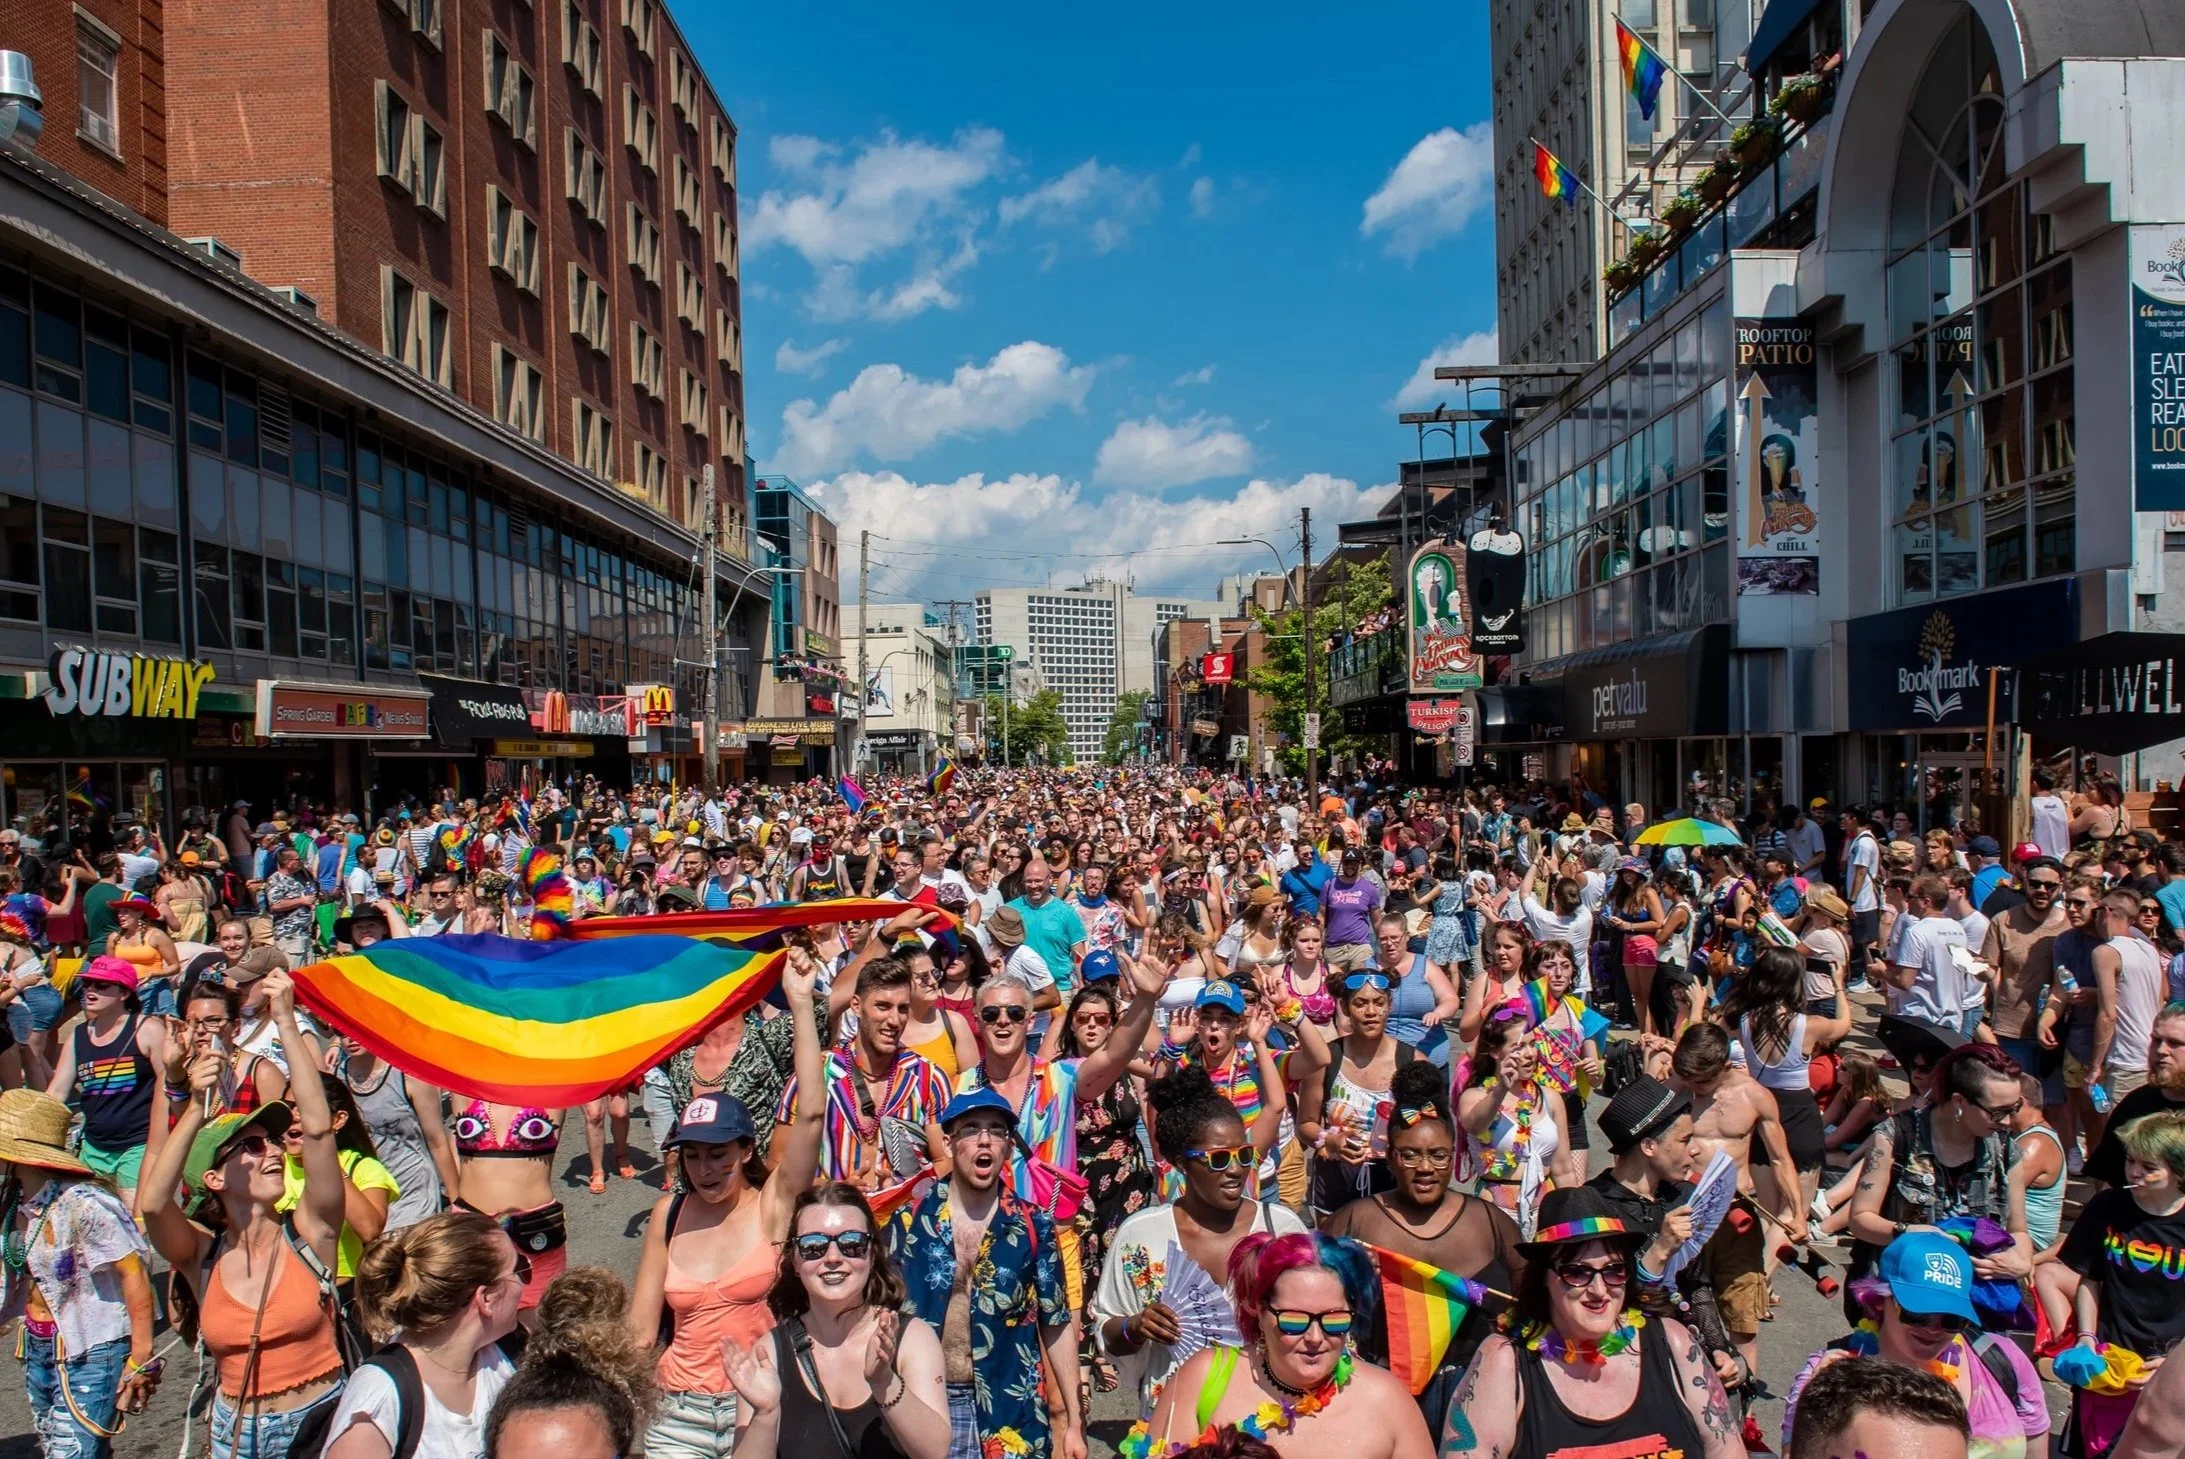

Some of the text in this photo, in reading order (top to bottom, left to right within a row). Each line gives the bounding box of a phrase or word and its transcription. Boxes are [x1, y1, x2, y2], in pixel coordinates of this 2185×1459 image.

[1739, 328, 1812, 344] ROOFTOP
[1739, 344, 1813, 366] PATIO
[1776, 542, 1808, 551] CHILL
[999, 647, 1010, 656] TD
[1899, 659, 1980, 693] Bookmark
[45, 650, 216, 719] SUBWAY
[276, 705, 304, 721] SPRING
[306, 707, 336, 722] GARDEN
[1410, 707, 1457, 716] TURKISH
[1416, 719, 1452, 730] DELIGHT
[1924, 1269, 1962, 1289] PRIDE
